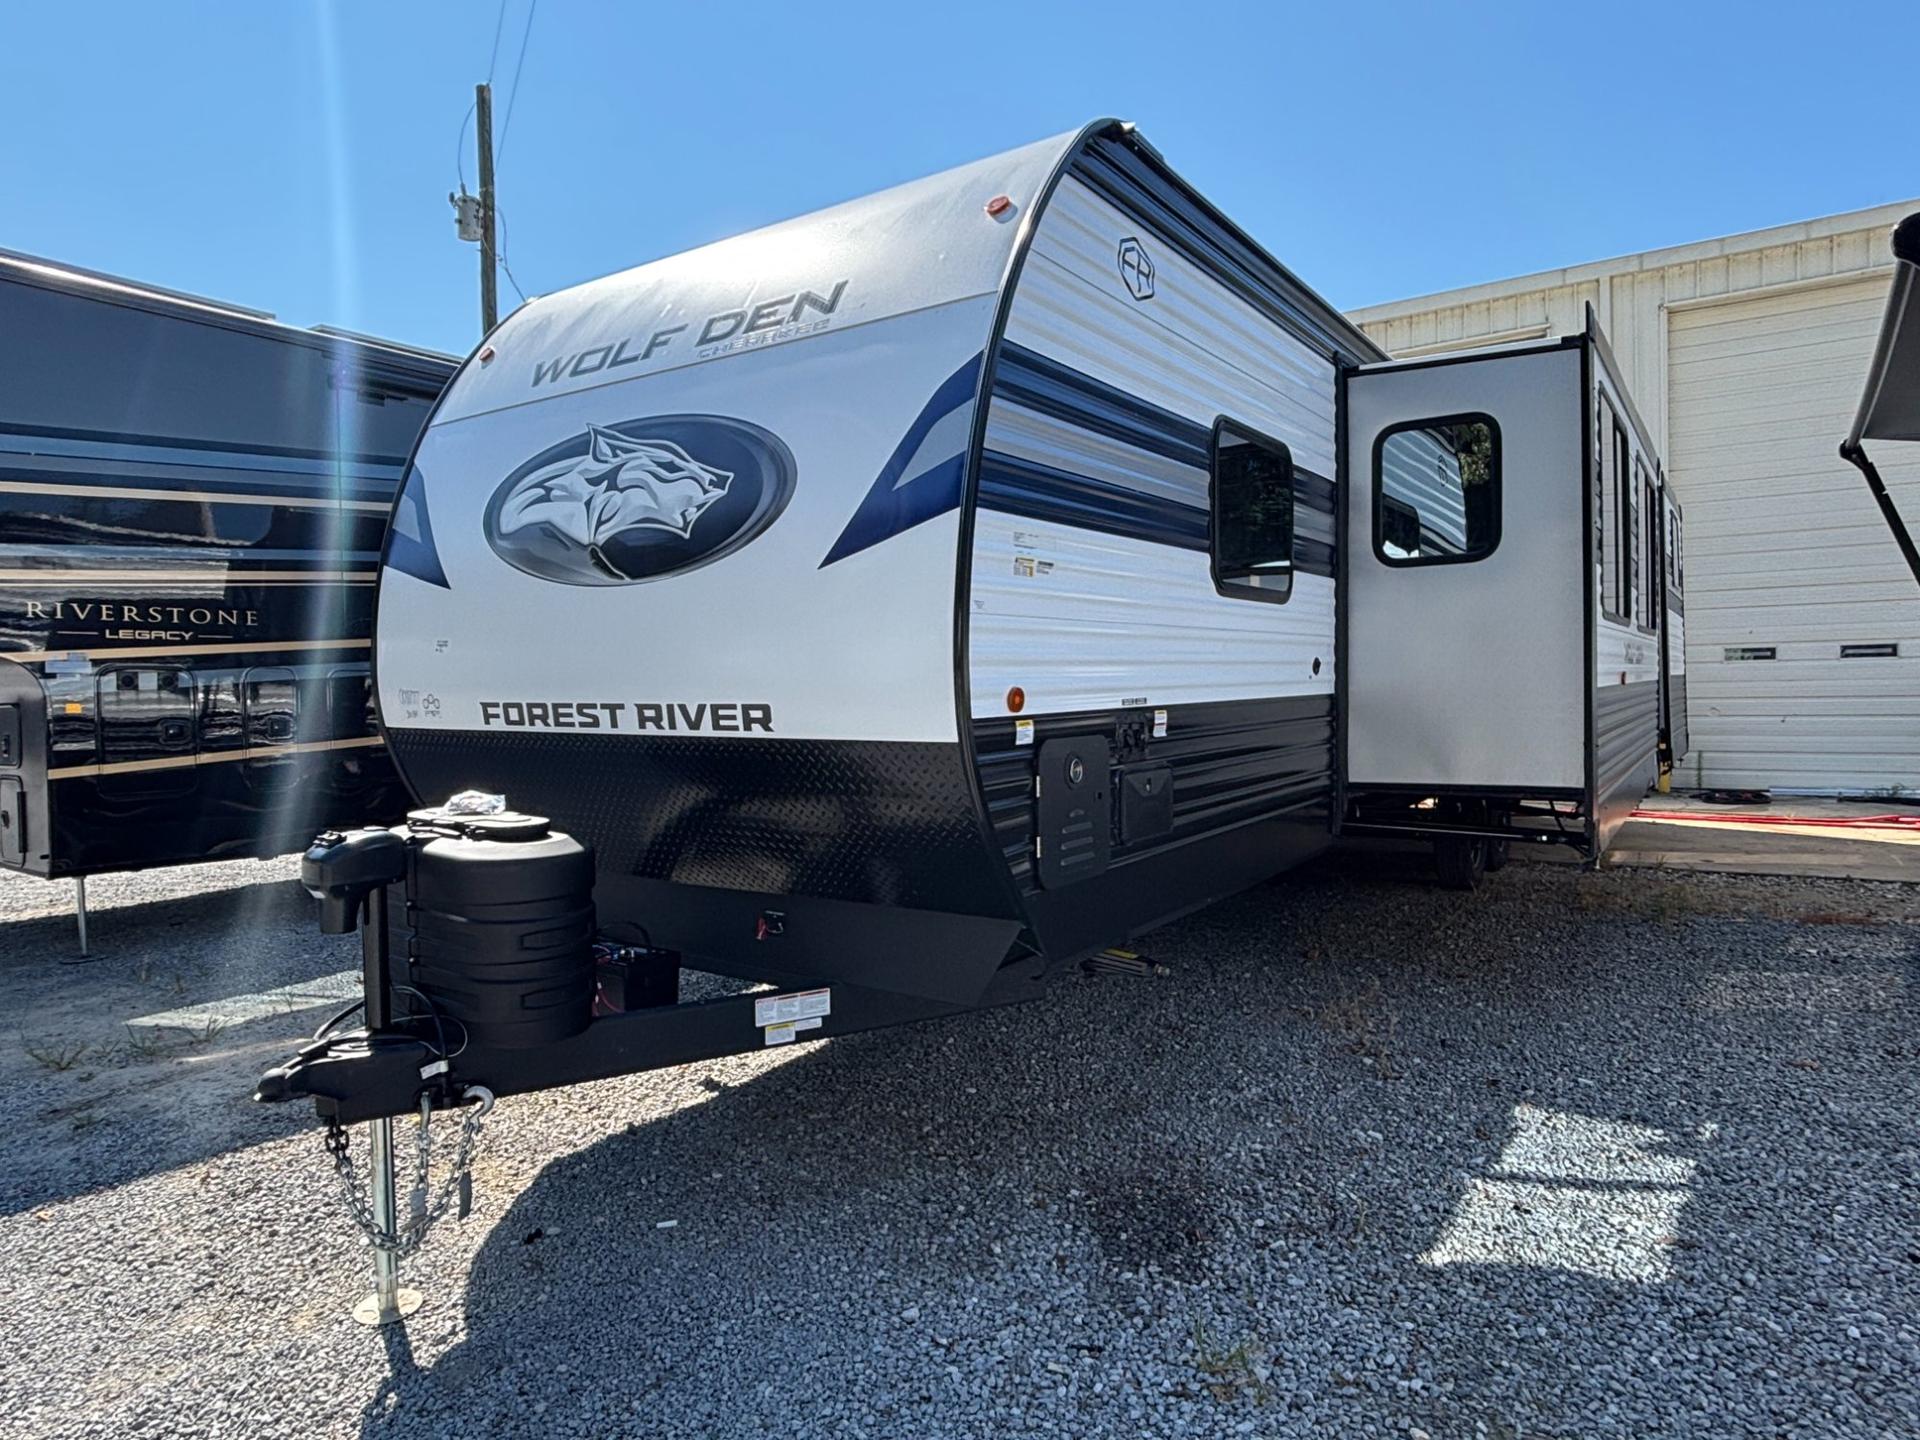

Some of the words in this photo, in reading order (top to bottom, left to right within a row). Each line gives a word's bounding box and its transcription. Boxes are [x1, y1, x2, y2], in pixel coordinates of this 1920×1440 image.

[531, 323, 689, 387] WOLF
[694, 279, 849, 348] DEN
[26, 601, 259, 626] RIVERSTONE
[105, 629, 194, 640] LEGACY
[480, 702, 625, 729] FOREST
[634, 703, 775, 733] RIVER
